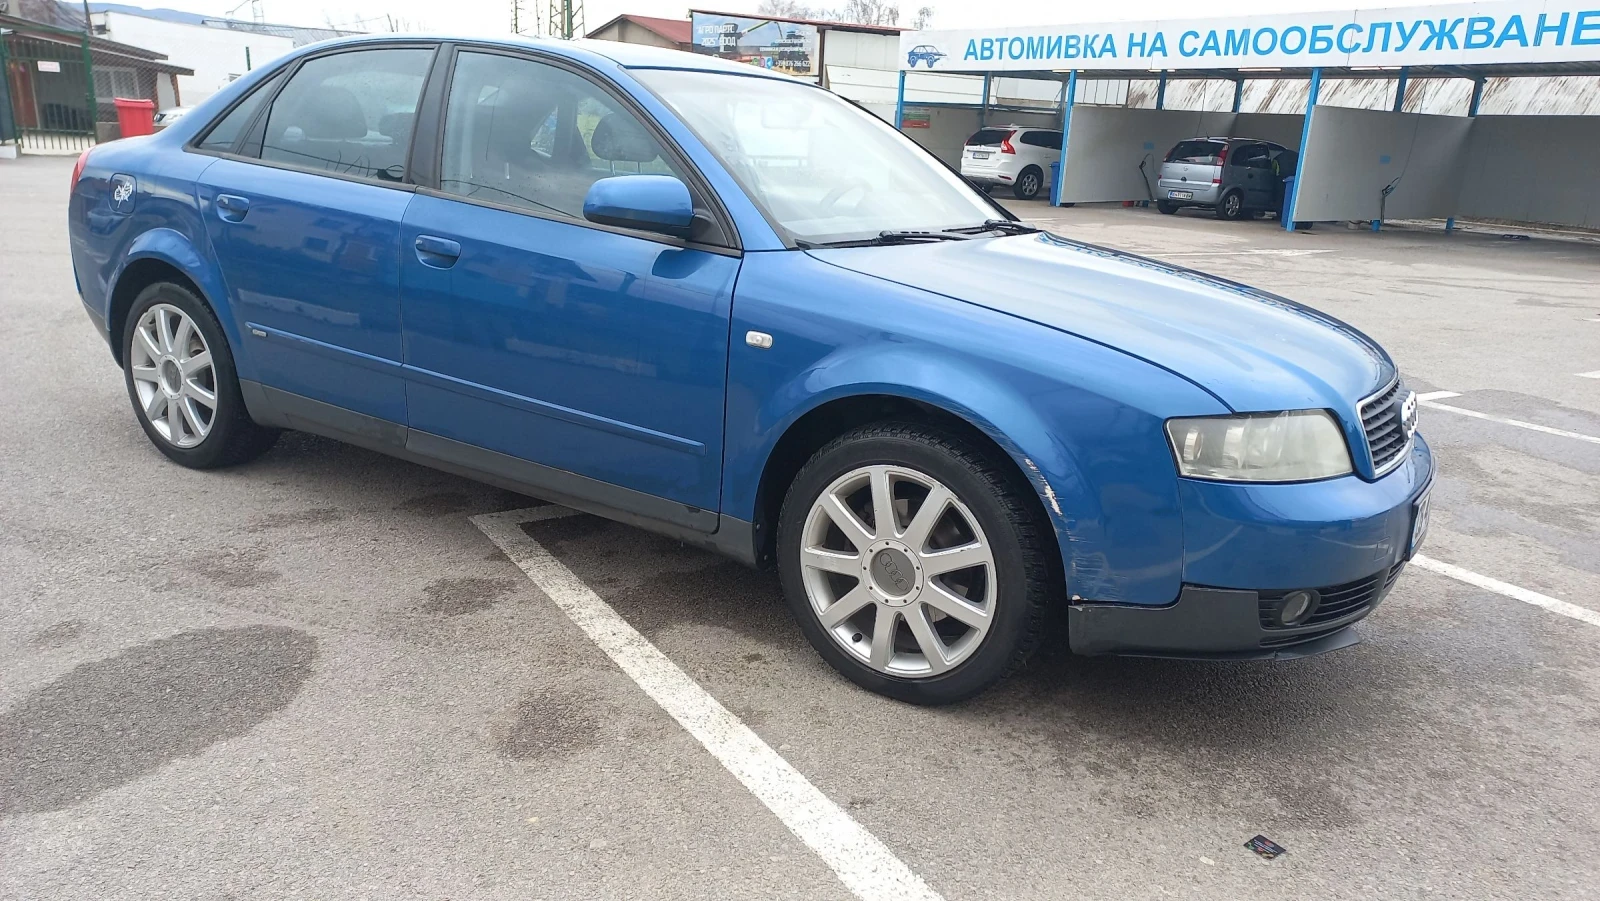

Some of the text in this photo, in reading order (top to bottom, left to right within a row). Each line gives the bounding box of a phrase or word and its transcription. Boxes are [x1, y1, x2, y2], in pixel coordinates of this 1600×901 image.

[963, 10, 1600, 61] АВТОМИВКА НА САМООБСЛУЖВАНЕ
